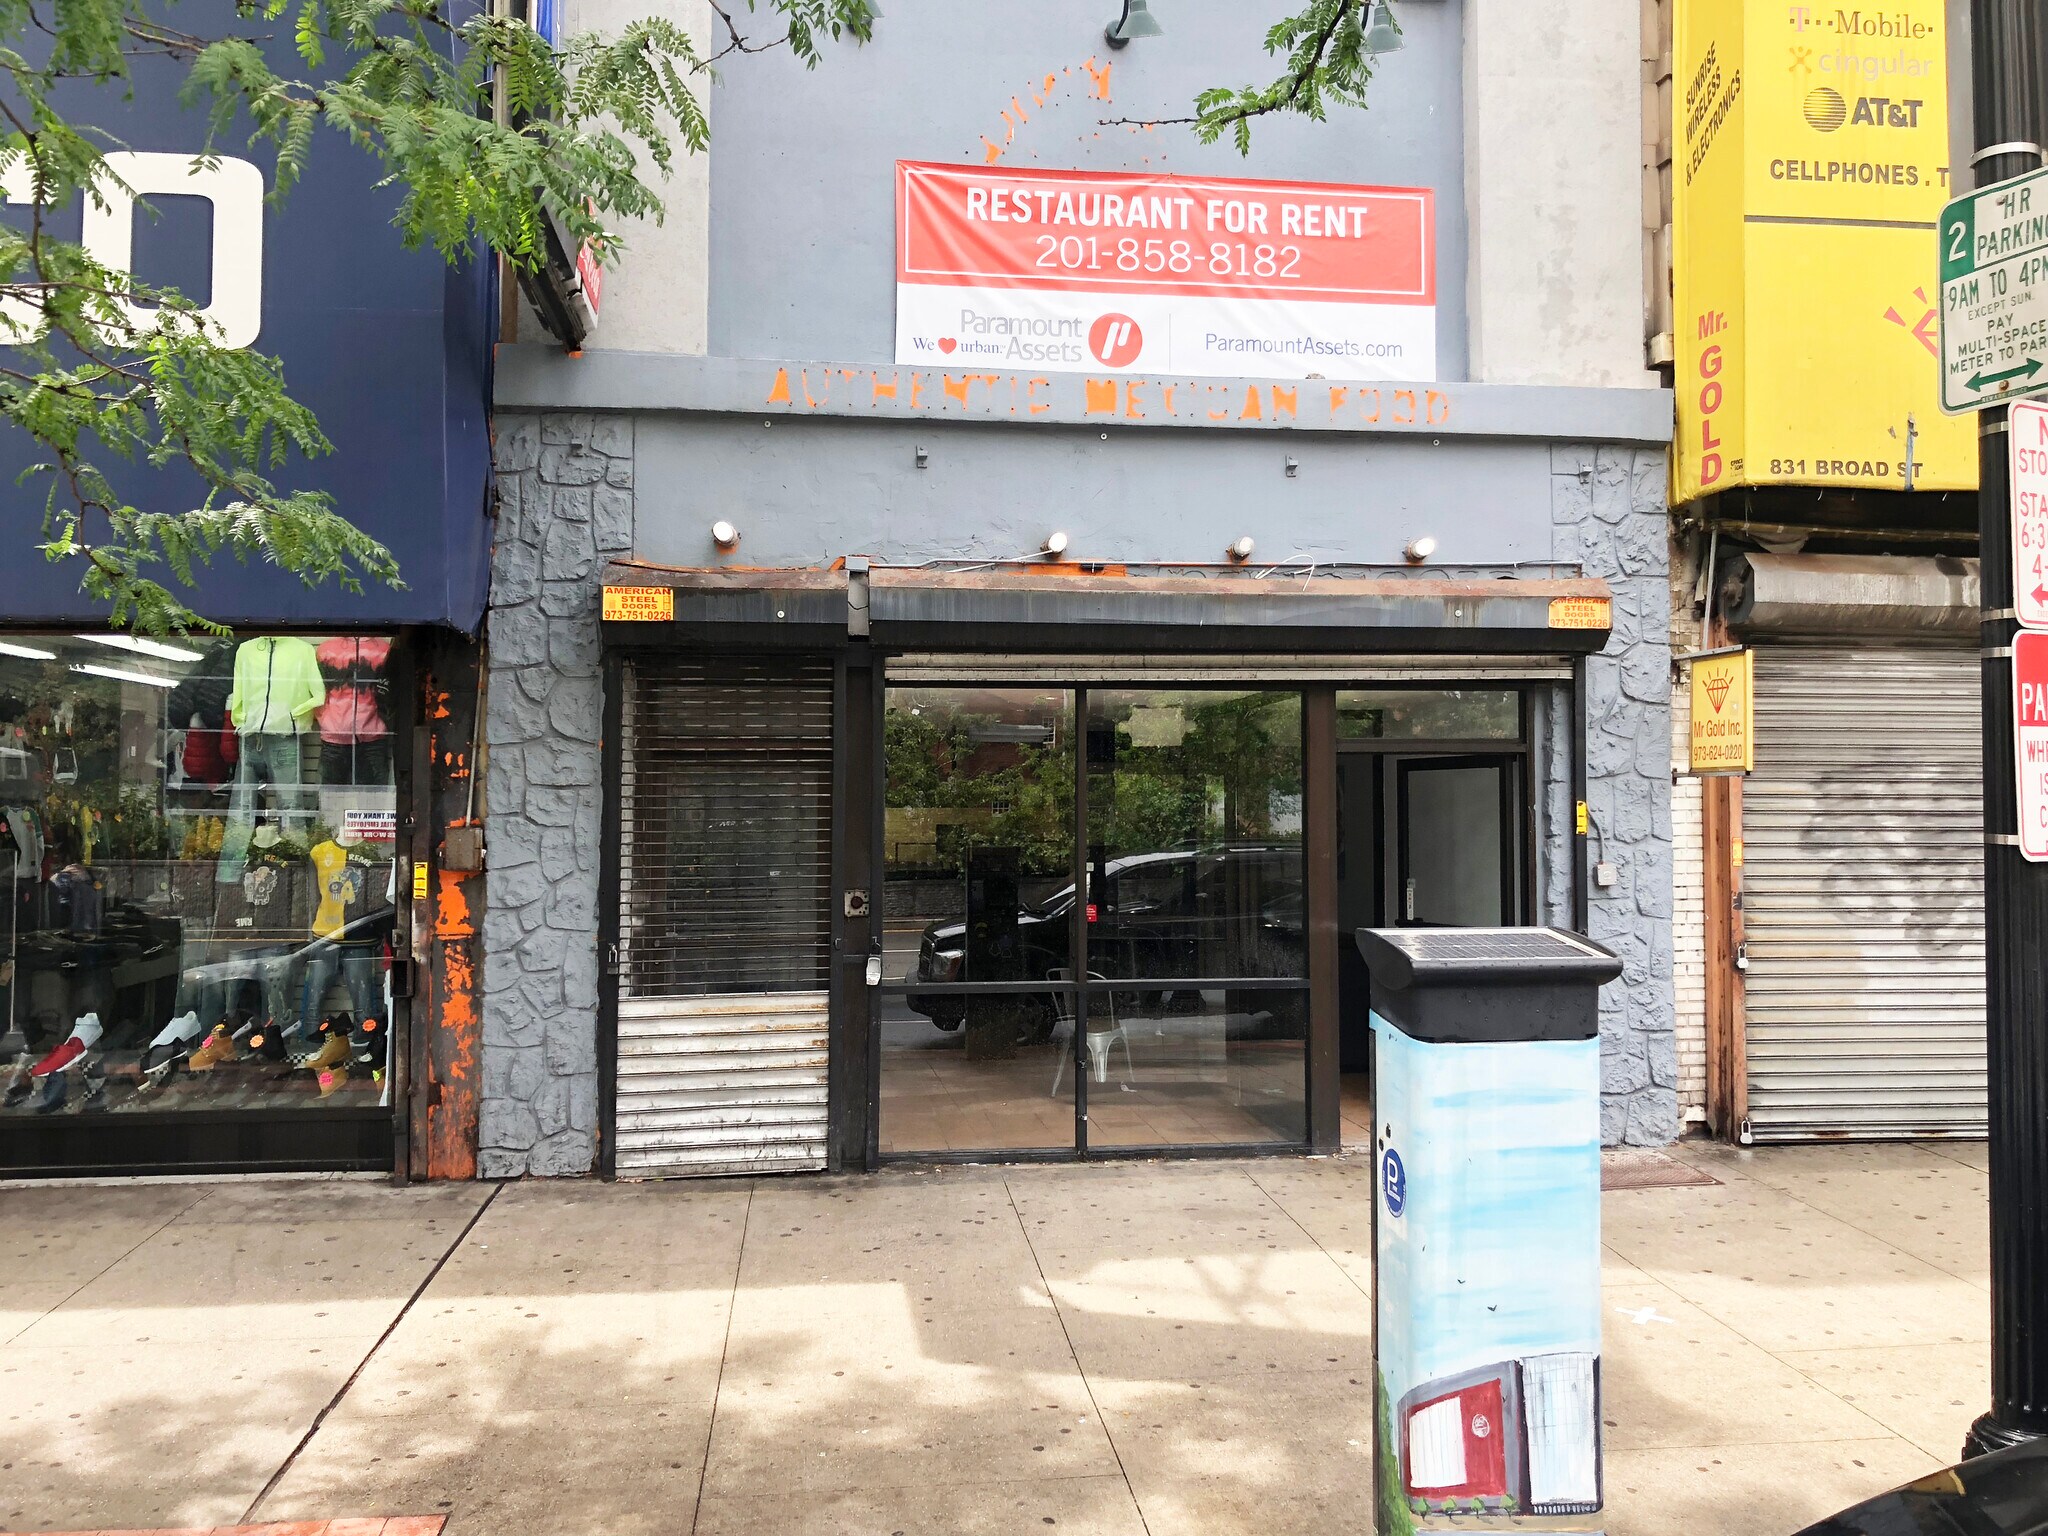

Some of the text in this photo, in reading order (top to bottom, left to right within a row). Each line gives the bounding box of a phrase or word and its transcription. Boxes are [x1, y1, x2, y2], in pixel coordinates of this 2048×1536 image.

[1686, 41, 1716, 113] SUNRISE
[1819, 49, 1933, 81] cingular
[1686, 66, 1720, 144] WIRELESS
[1851, 97, 1923, 128] AT&T
[1692, 69, 1741, 174] ELECTRONICS
[1770, 159, 1919, 187] CELLPHONES
[966, 186, 1368, 238] RESTAURANT FOR RENT
[2004, 187, 2031, 219] HR
[1035, 235, 1301, 278] 201-858-8182
[1948, 221, 1967, 262] 2
[1948, 278, 1980, 311] 9AM
[1989, 268, 2007, 298] TO
[960, 309, 1082, 338] Paramount
[1968, 299, 2006, 321] EXCEPT
[1987, 313, 2014, 332] PAY
[1698, 310, 1728, 341] Mr.
[1958, 319, 2047, 357] MULTI-SPACE
[912, 337, 935, 351] We
[1006, 336, 1082, 363] Assets
[1205, 333, 1403, 358] ParamountAssets.com
[1950, 352, 1993, 375] METER
[1999, 346, 2015, 361] TO
[1699, 344, 1723, 486] GOLD
[1770, 459, 1924, 479] 831 BROAD ST
[605, 587, 671, 595] AMERICAN
[604, 610, 672, 620] 973-751-0226
[1550, 619, 1608, 627] 973-751-0226
[2021, 683, 2048, 721] PA
[1694, 718, 1743, 738] Mr Gold Inc.
[1694, 744, 1743, 761] 973-624-0220
